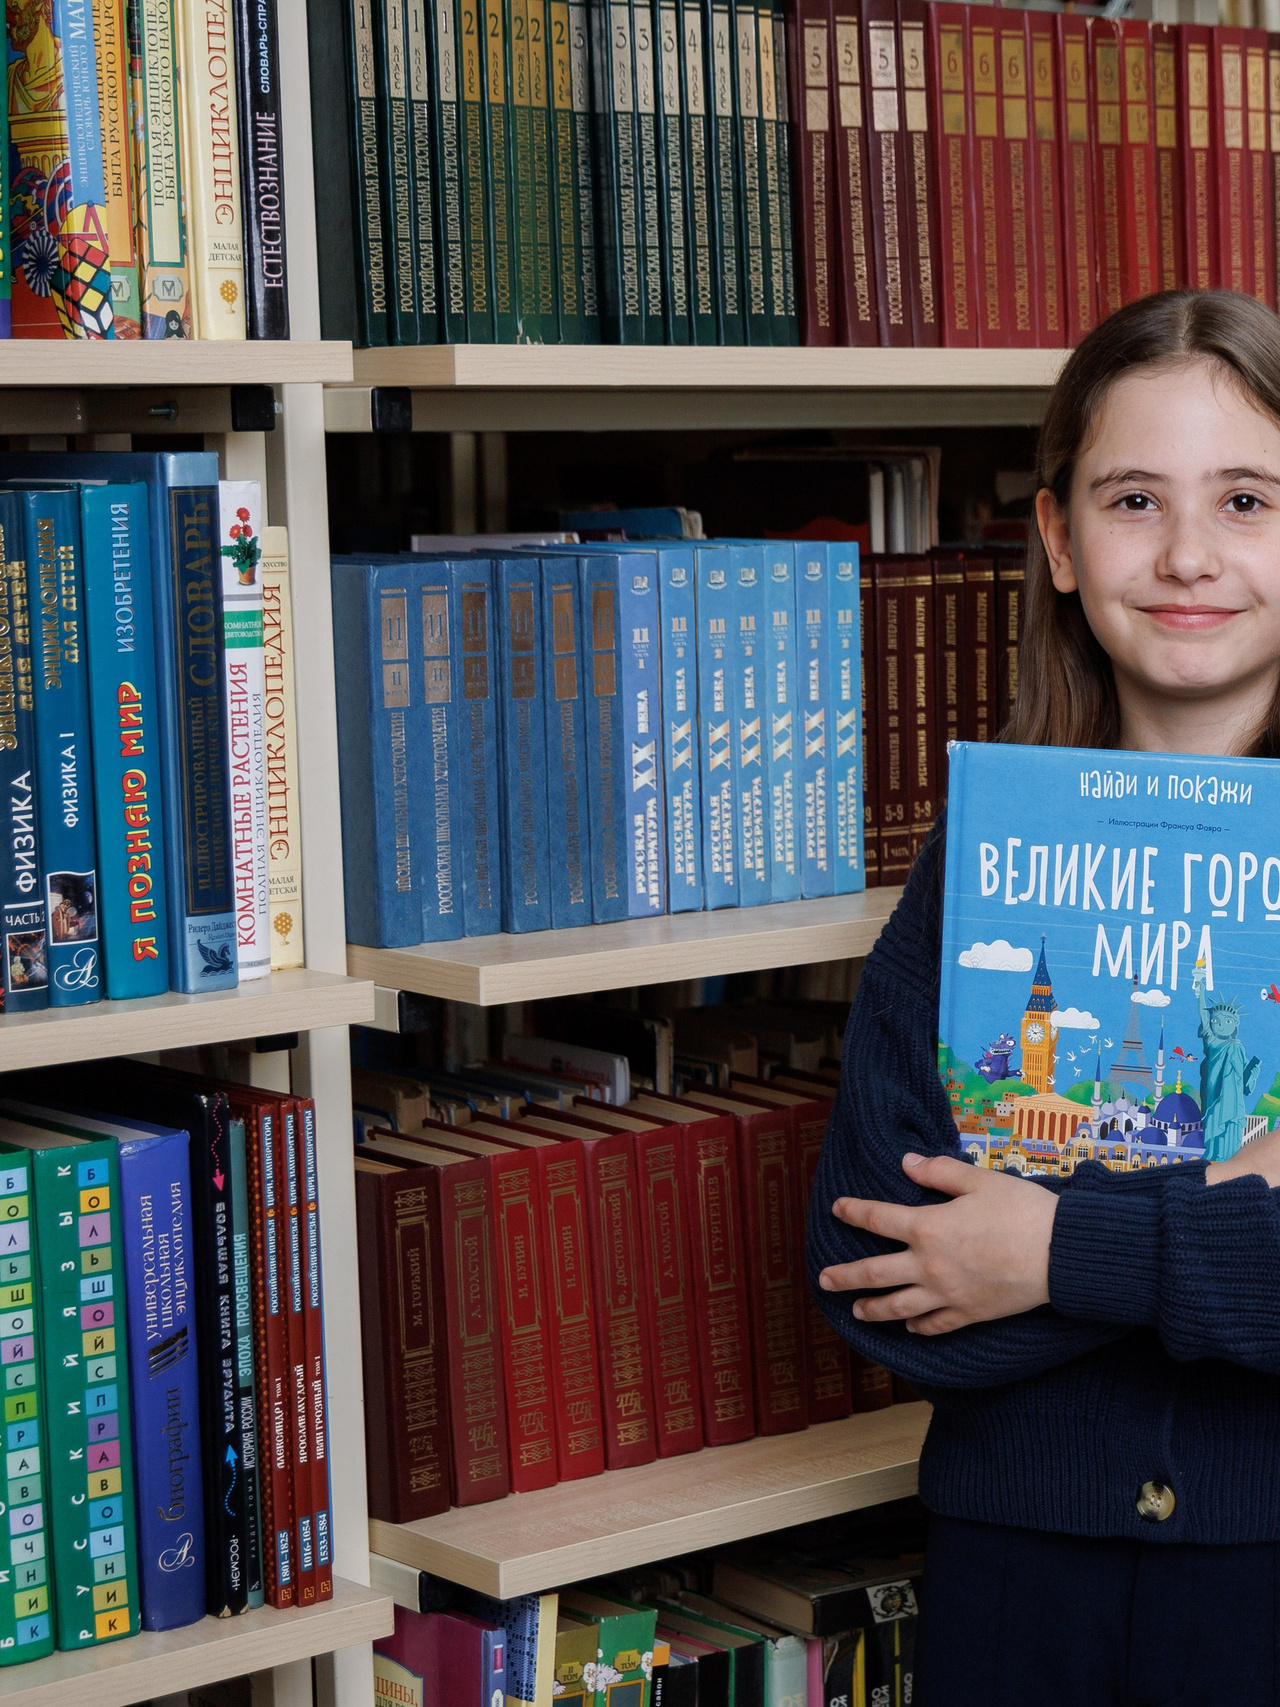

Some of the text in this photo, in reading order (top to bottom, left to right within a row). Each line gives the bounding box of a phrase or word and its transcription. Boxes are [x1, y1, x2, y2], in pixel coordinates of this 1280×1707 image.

[359, 5, 366, 30] 1
[464, 10, 475, 36] 2
[947, 50, 958, 74] 6
[69, 43, 89, 187] ЭНЦИКЛОПЕДИЧЕСКИЙ
[79, 45, 96, 150] СЛОВАРЬ ЮНОГО
[105, 51, 120, 144] РУССКОГО
[159, 56, 176, 200] БЫТА РУССКОГО
[108, 149, 123, 198] БЫТА
[150, 129, 165, 207] ПОЛНАЯ
[256, 110, 284, 289] ЕСТЕСТВОЗНАНИЕ
[361, 100, 387, 314] РОССИЙСКАЯ ШКОЛЬНАЯ ХРЕСТОМАТИЯ
[392, 100, 413, 314] РОССИЙСКАЯ ШКОЛЬНАЯ ХРЕСТОМАТИЯ
[208, 252, 242, 263] ДЕТСКАЯ
[213, 242, 239, 251] МАЛАЯ
[6, 560, 30, 645] ДЕТЕЙ
[37, 518, 62, 691] ЭНЦИКЛОПЕДИЯ
[58, 545, 80, 664] ДЛЯ ДЕТЕЙ
[110, 502, 136, 654] ИЗОБРЕТЕНИЯ
[183, 502, 218, 687] СЛОВАРЬ
[428, 614, 443, 637] 11
[16, 657, 34, 711] ДЛЯ
[632, 628, 649, 643] 11
[262, 583, 291, 860] ЭНЦИКЛОПЕДИЯ
[632, 689, 656, 792] XX ВЕКА
[671, 667, 692, 771] XX ВЕКА
[708, 668, 731, 772] XX ВЕКА
[804, 658, 826, 760] XX ВЕКА
[914, 596, 928, 788] ХРЕСТОМАТИЯ ПО ЗАРУБЕЖНОЙ ЛИТЕРАТУРЕ
[10, 769, 37, 893] ФИЗИКА
[60, 744, 79, 828] ФИЗИКА
[116, 680, 160, 962] Я ПОЗНАЮ МИР
[187, 695, 211, 892] ИЛЛЮСТРИРОВАННЫЙ
[204, 692, 226, 894] ЭНЦИКЛОПЕДИЧЕСКИЙ
[229, 662, 256, 948] КОМНАТНЫЕ РАСТЕНИЯ
[250, 692, 267, 915] ПОЛНАЯ ЭНЦИКЛОПЕДИЯ
[432, 706, 454, 915] РОССИЙСКАЯ ШКОЛЬНАЯ ХРЕСТОМАТИЯ
[672, 795, 685, 875] РУССКАЯ
[682, 779, 696, 887] ЛИТЕРАТУРА
[710, 794, 721, 874] РУССКАЯ
[721, 779, 734, 887] ЛИТЕРАТУРА
[804, 781, 816, 860] РУССКАЯ
[815, 766, 827, 872] ЛИТЕРАТУРА
[914, 801, 931, 820] 5-9
[1107, 817, 1222, 834] Иллюстрации Франсуа Фояра
[1147, 776, 1159, 797] и
[269, 886, 298, 896] ЕТСКАЯ
[634, 814, 648, 895] РУССКАЯ
[647, 797, 660, 909] ЛИТЕРАТУРА
[978, 836, 1159, 916] ВЕЛИКИЕ
[5, 912, 40, 927] ЧАСТЬ
[1092, 920, 1215, 992] МИРА
[263, 1116, 279, 1314] РОССИЙСКИЕ КНЯЗЬЯ ЦАРИ, ИМПЕРАТОРЫ
[286, 1114, 302, 1311] РОССИЙСКИЕ КНЯЗЬЯ ЦАРИ, ИМПЕРАТОРЫ
[304, 1110, 319, 1307] РОССИЙСКИЕ КНЯЗЬЯ ЦАРИ, ИМПЕРАТОРЫ
[561, 1224, 576, 1289] И. БУНИН
[609, 1191, 628, 1305] Ф. ДОСТОЕВСКИЙ
[660, 1200, 674, 1279] Л. ТОЛСТОЙ
[707, 1175, 725, 1275] И. ТУРГЕНЕВ
[769, 1179, 782, 1265] Н. НЕКРАСОВ
[6, 1176, 25, 1360] БОЛЬШОЙ
[87, 1168, 107, 1352] БОЛЬШОЙ
[233, 1233, 252, 1378] ЭПОХА ПРОСВЕЩЕНИЯ
[407, 1246, 424, 1326] М. ГОРЬКИЙ
[465, 1235, 481, 1319] Л. ТОЛСТОЙ
[514, 1234, 529, 1298] И. БУНИН
[216, 1202, 235, 1434] БОЛЬШАЯ КНИГА ЭРУДИТА
[56, 1163, 94, 1642] РУССКИЙ ЯЗЫК
[240, 1396, 255, 1470] ИСТОРИЯ РОССИИ
[275, 1406, 285, 1469] АЛЕКСАНДР
[294, 1364, 308, 1463] ЯРОСЛАВ МУДРЫЙ
[312, 1379, 324, 1460] ИВАН ГРОЗНЫЙ
[14, 1372, 41, 1639] СПРАВОЧНИК
[94, 1364, 120, 1632] СПРАВОЧНИК
[156, 1388, 191, 1522] биографии
[302, 1519, 313, 1568] 1016-1054
[318, 1513, 328, 1562] 1533-1584
[562, 1673, 578, 1682] ТОМ
[621, 1661, 637, 1670] ТОМ
